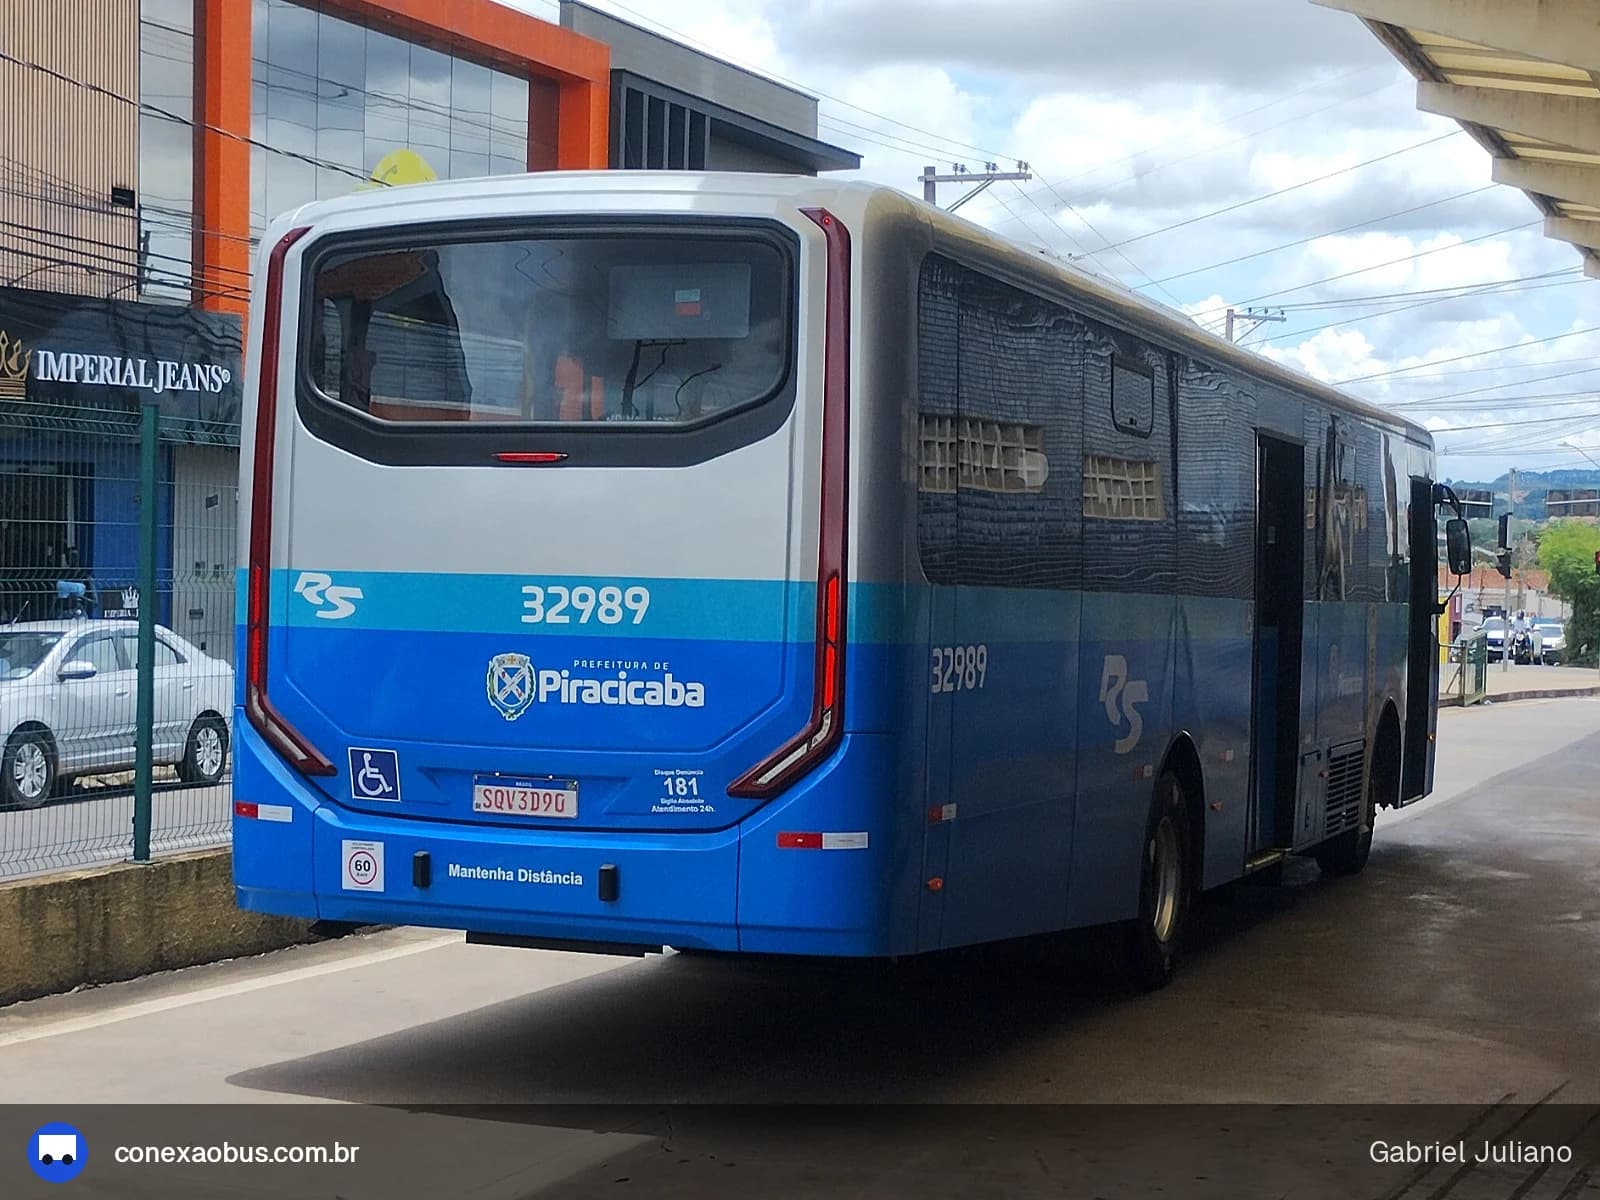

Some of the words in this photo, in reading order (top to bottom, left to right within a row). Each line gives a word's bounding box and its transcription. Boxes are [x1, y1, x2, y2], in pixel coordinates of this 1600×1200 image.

[36, 350, 152, 388] IMPERIAL
[294, 572, 364, 619] RS
[520, 586, 650, 625] 32989
[574, 660, 647, 670] PREFEITURA
[654, 662, 669, 671] DE
[931, 644, 987, 694] 32989
[538, 669, 705, 708] Piracicaba
[1099, 655, 1149, 755] RS
[483, 788, 565, 813] SQV3D90
[663, 777, 698, 796] 181
[651, 805, 699, 813] Atendimento
[354, 859, 371, 872] 60
[448, 863, 514, 882] Mantenha
[517, 869, 583, 886] Distância
